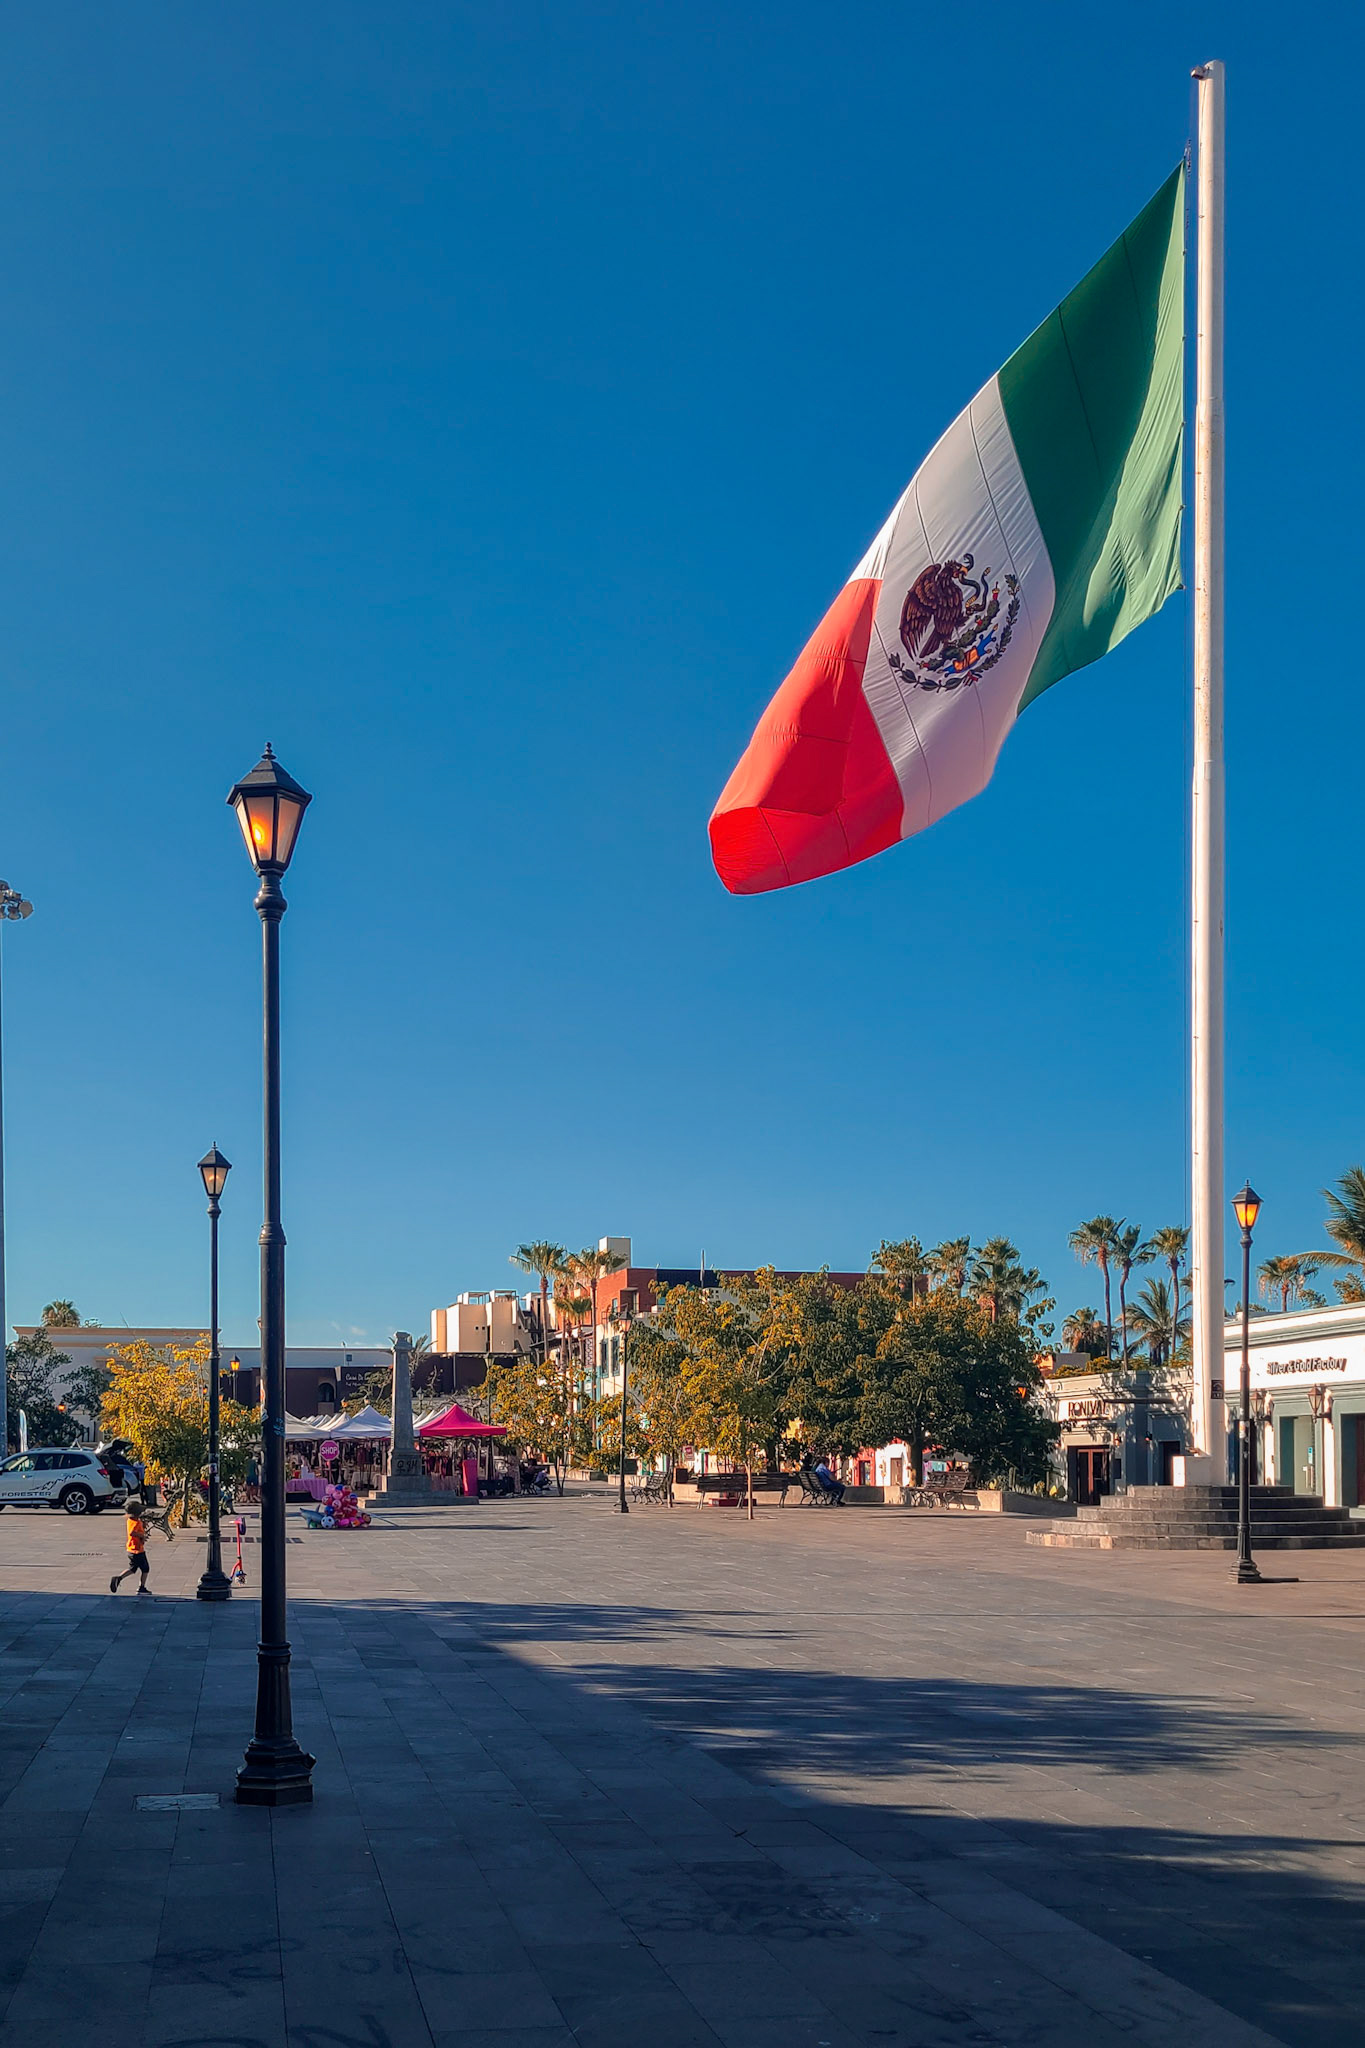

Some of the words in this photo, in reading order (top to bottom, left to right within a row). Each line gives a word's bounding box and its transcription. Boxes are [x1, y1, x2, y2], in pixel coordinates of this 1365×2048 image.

[1294, 1358, 1313, 1373] Gold
[1312, 1356, 1347, 1372] Factory
[321, 1446, 338, 1455] SHOP
